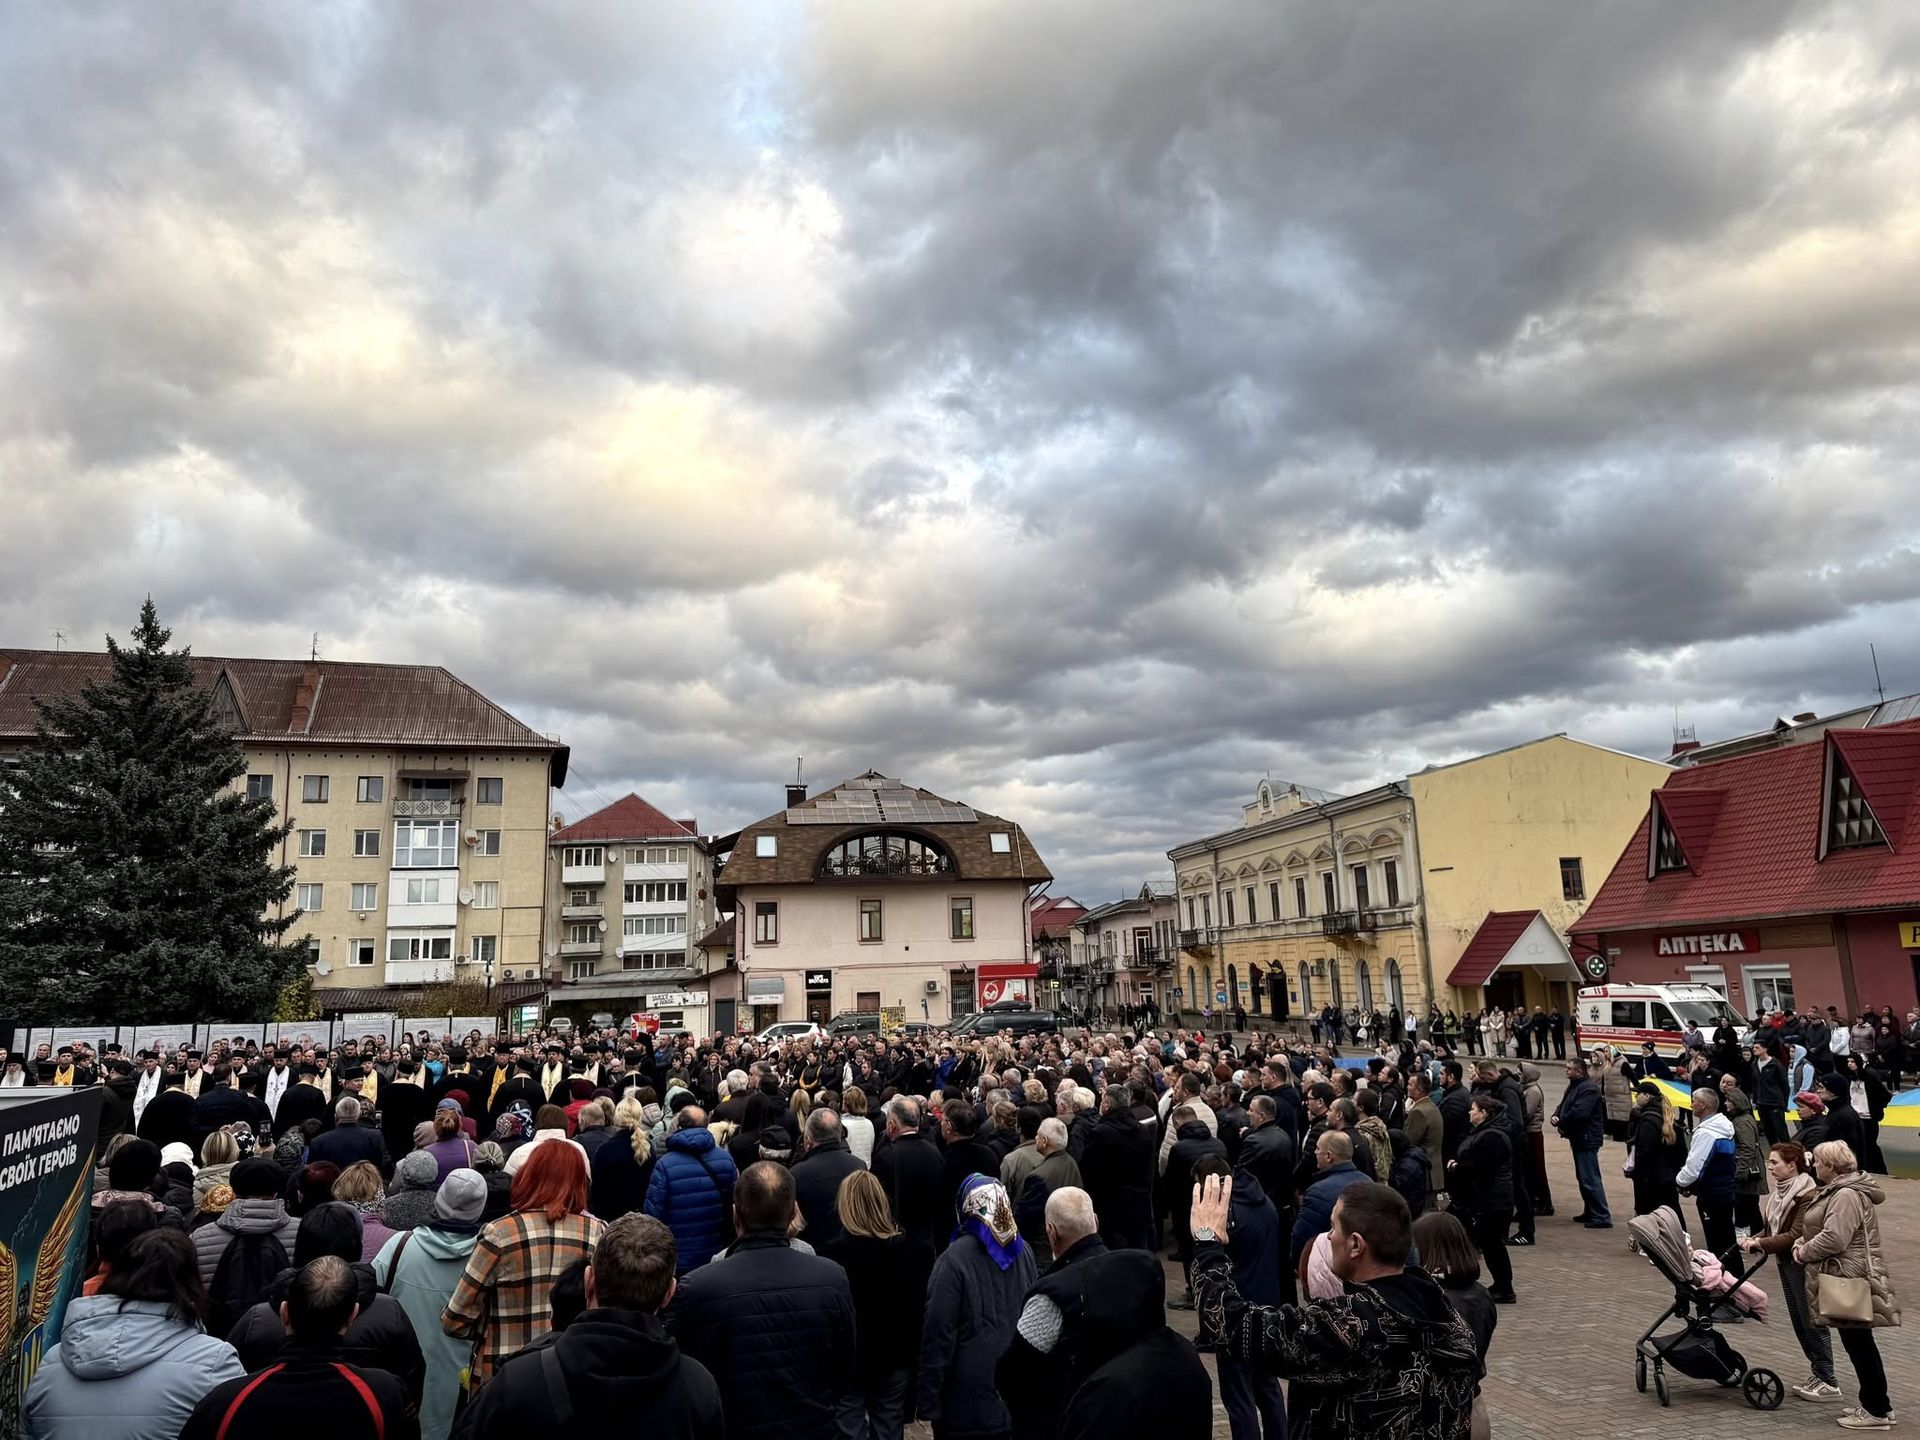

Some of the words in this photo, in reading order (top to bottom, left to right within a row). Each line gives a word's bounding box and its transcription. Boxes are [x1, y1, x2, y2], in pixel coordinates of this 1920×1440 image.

[1659, 933, 1744, 955] АПТЕКА
[3, 1114, 80, 1157] ПАМ'ЯТАЄМО
[0, 1153, 37, 1191] СВОЇХ
[38, 1140, 77, 1177] ГЕРОЇВ
